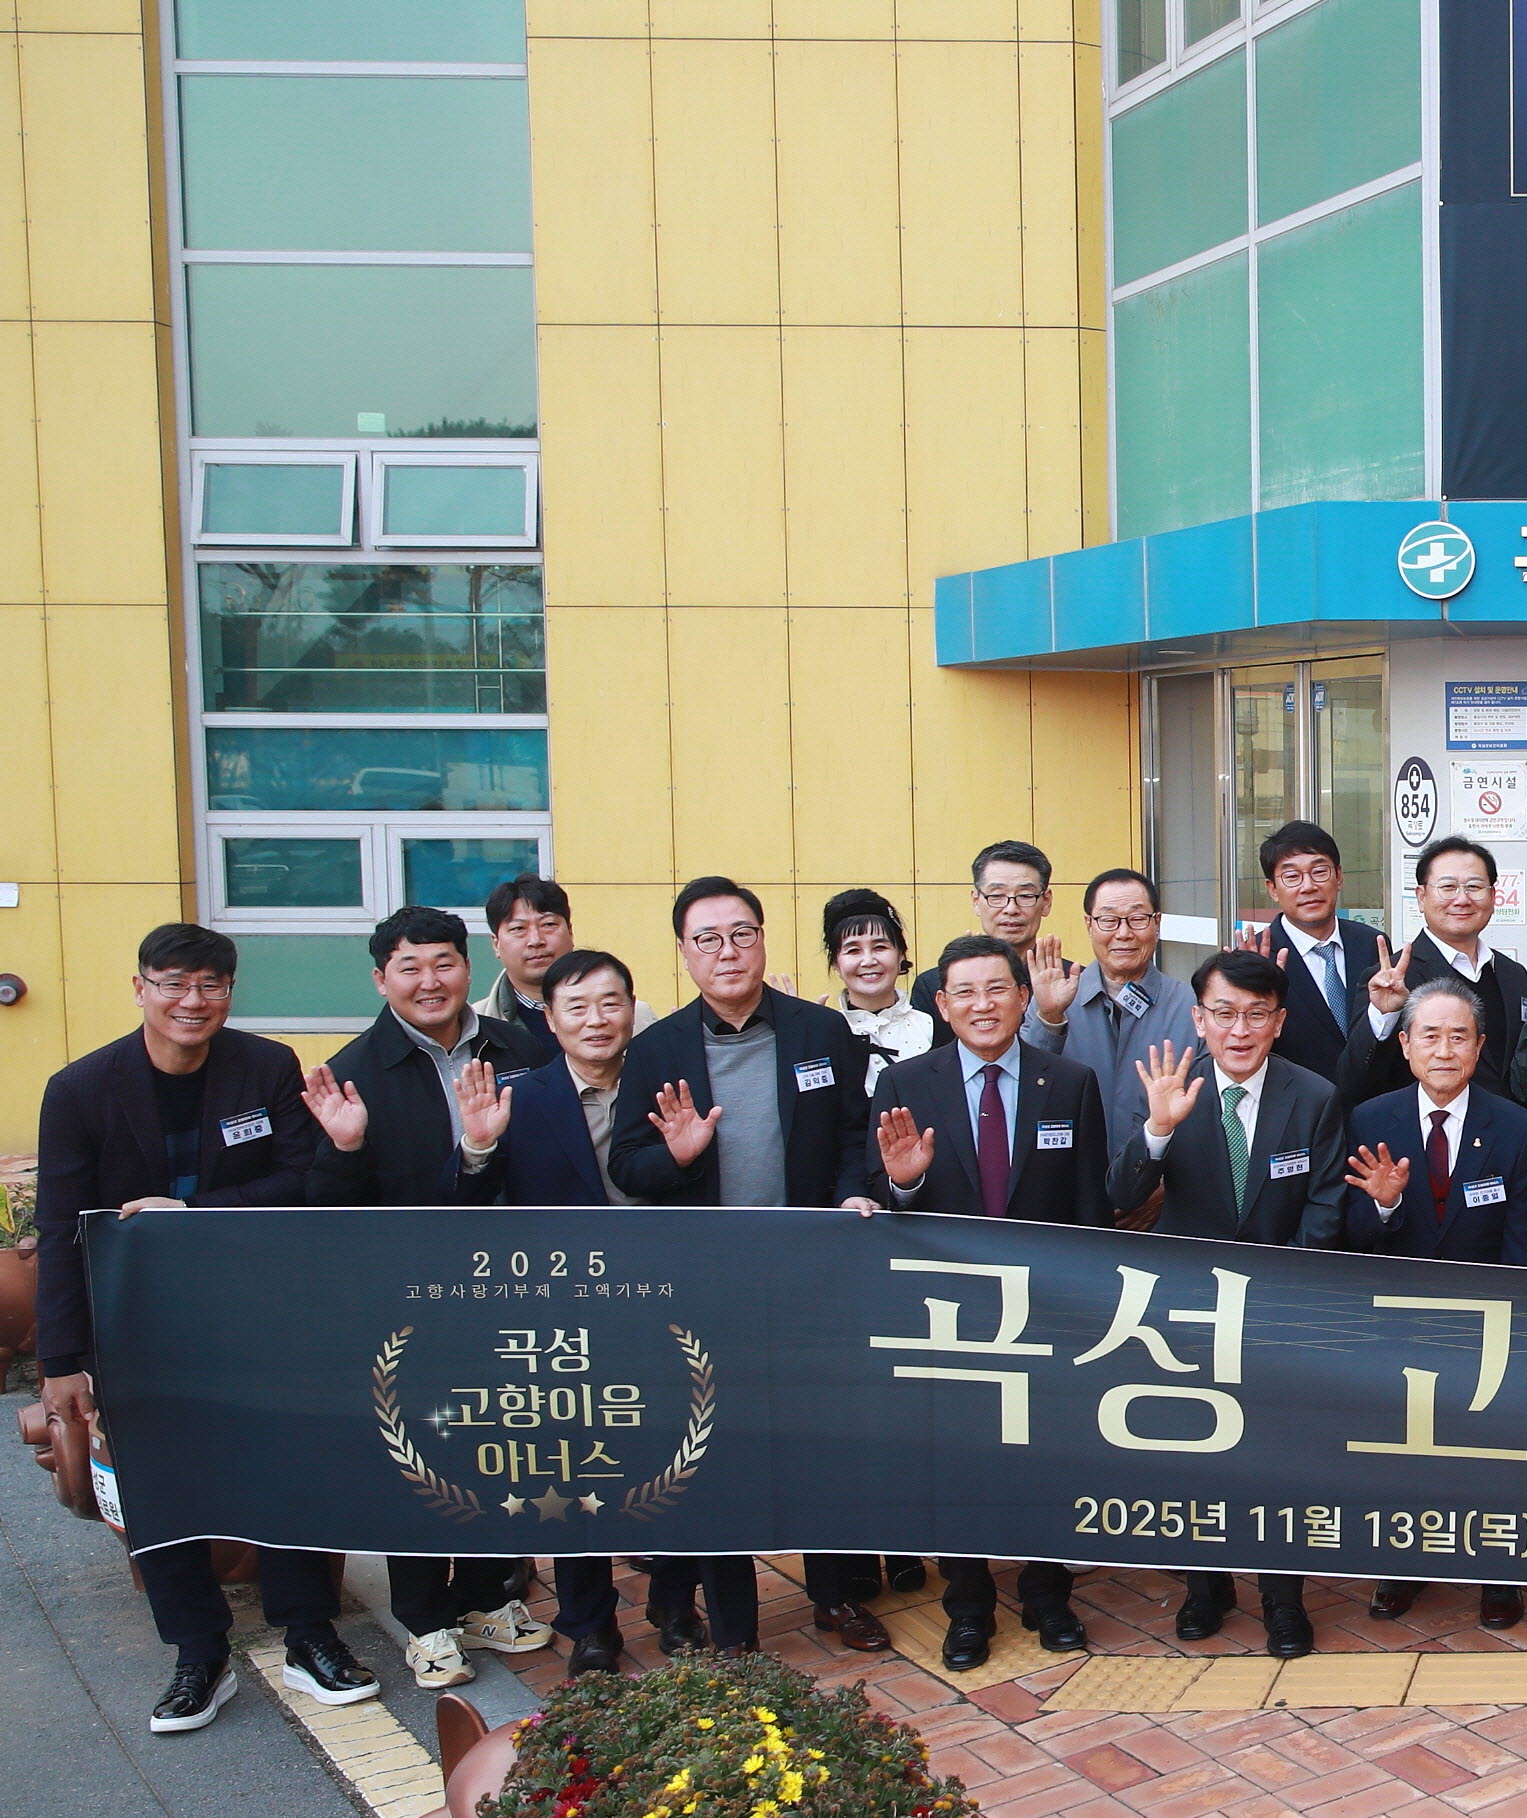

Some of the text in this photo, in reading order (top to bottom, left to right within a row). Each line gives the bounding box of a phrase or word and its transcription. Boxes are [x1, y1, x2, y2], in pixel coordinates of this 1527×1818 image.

[1453, 686, 1473, 694] CCTV
[1462, 776, 1517, 789] 금연시설
[1401, 793, 1430, 819] 854
[1495, 908, 1520, 916] 상담전화
[472, 1250, 607, 1277] 2025
[405, 1282, 675, 1300] 고향사랑기부제 고액기부자
[493, 1327, 591, 1373] 곡성
[869, 1258, 1252, 1453] 곡성
[448, 1383, 647, 1428] 고향이음
[476, 1438, 625, 1483] 아너스
[1074, 1496, 1228, 1543] 2025년
[1249, 1504, 1342, 1549] 11월
